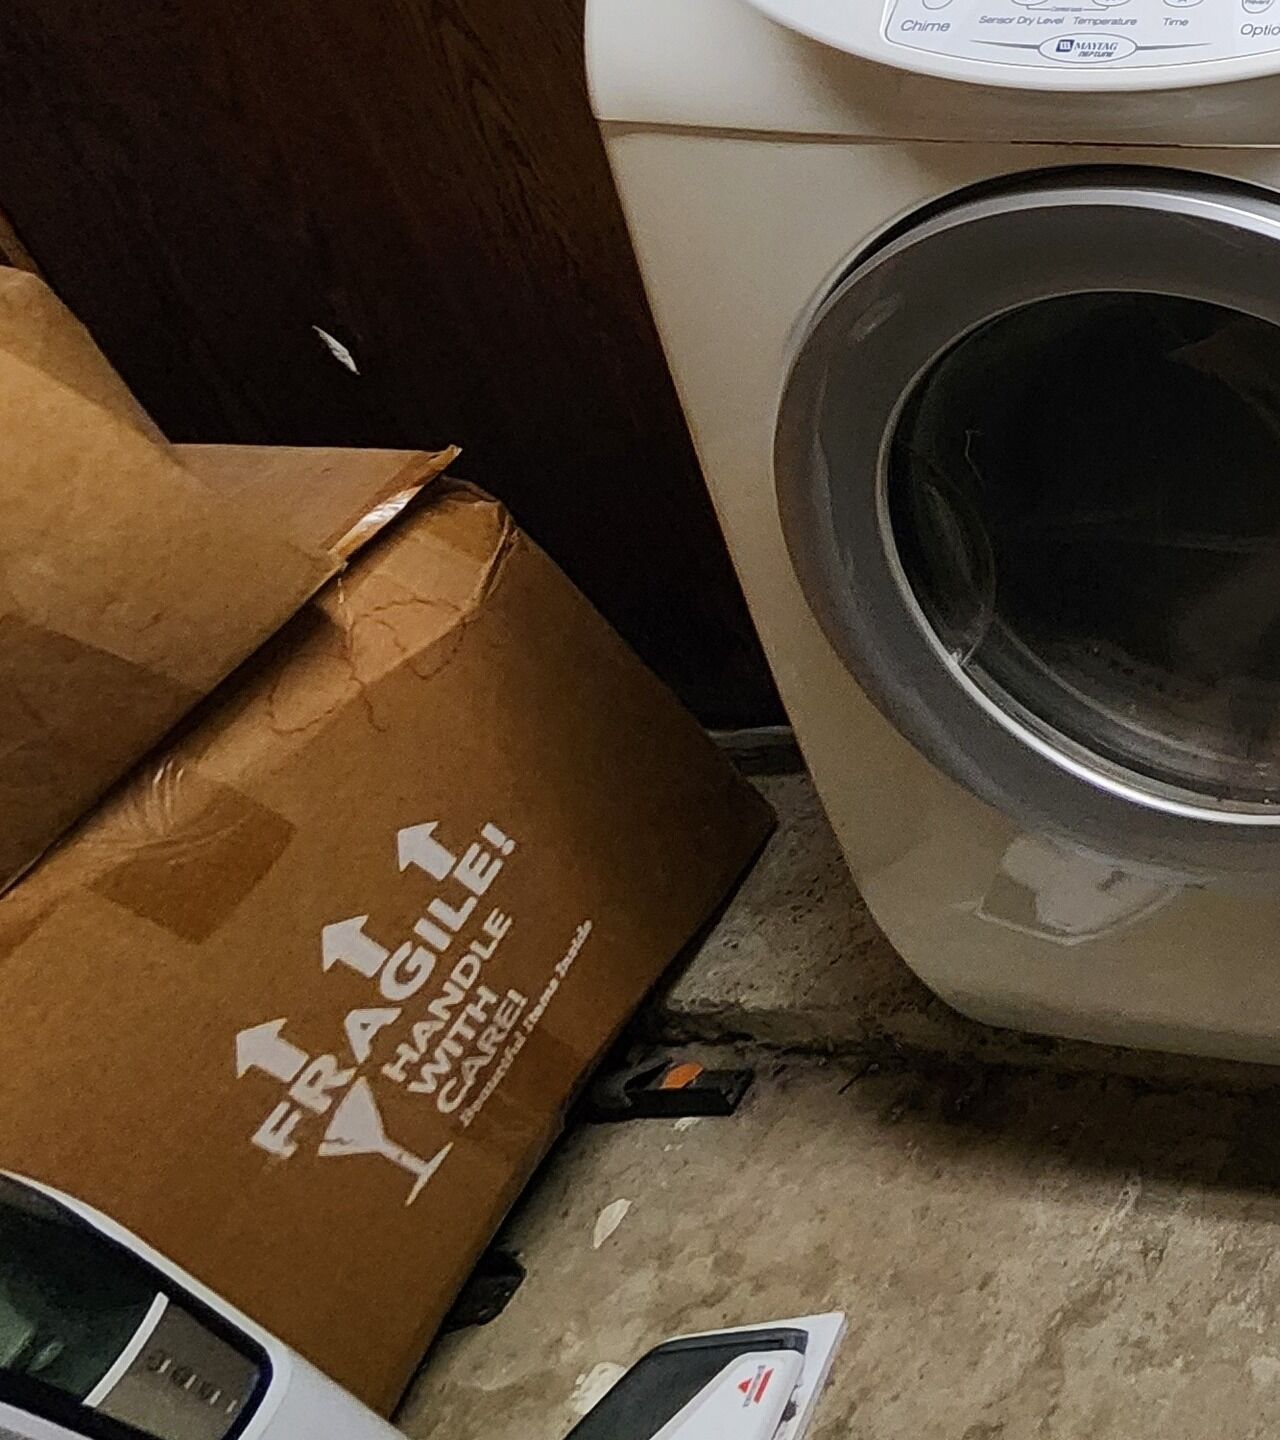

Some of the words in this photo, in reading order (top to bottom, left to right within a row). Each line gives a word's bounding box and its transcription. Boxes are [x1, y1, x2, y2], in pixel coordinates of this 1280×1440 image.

[900, 19, 951, 32] Chime
[978, 15, 1015, 25] Sensor
[1016, 15, 1036, 25] Dry
[1037, 15, 1065, 25] Level
[1073, 16, 1137, 27] Temperature
[1163, 17, 1189, 26] Time
[1074, 41, 1118, 51] MAYTAG
[251, 822, 516, 1159] FRAGILE!
[381, 907, 512, 1081] HANDLE
[525, 978, 560, 1032] Items
[408, 985, 498, 1094] WITH
[437, 989, 528, 1113] CARE!
